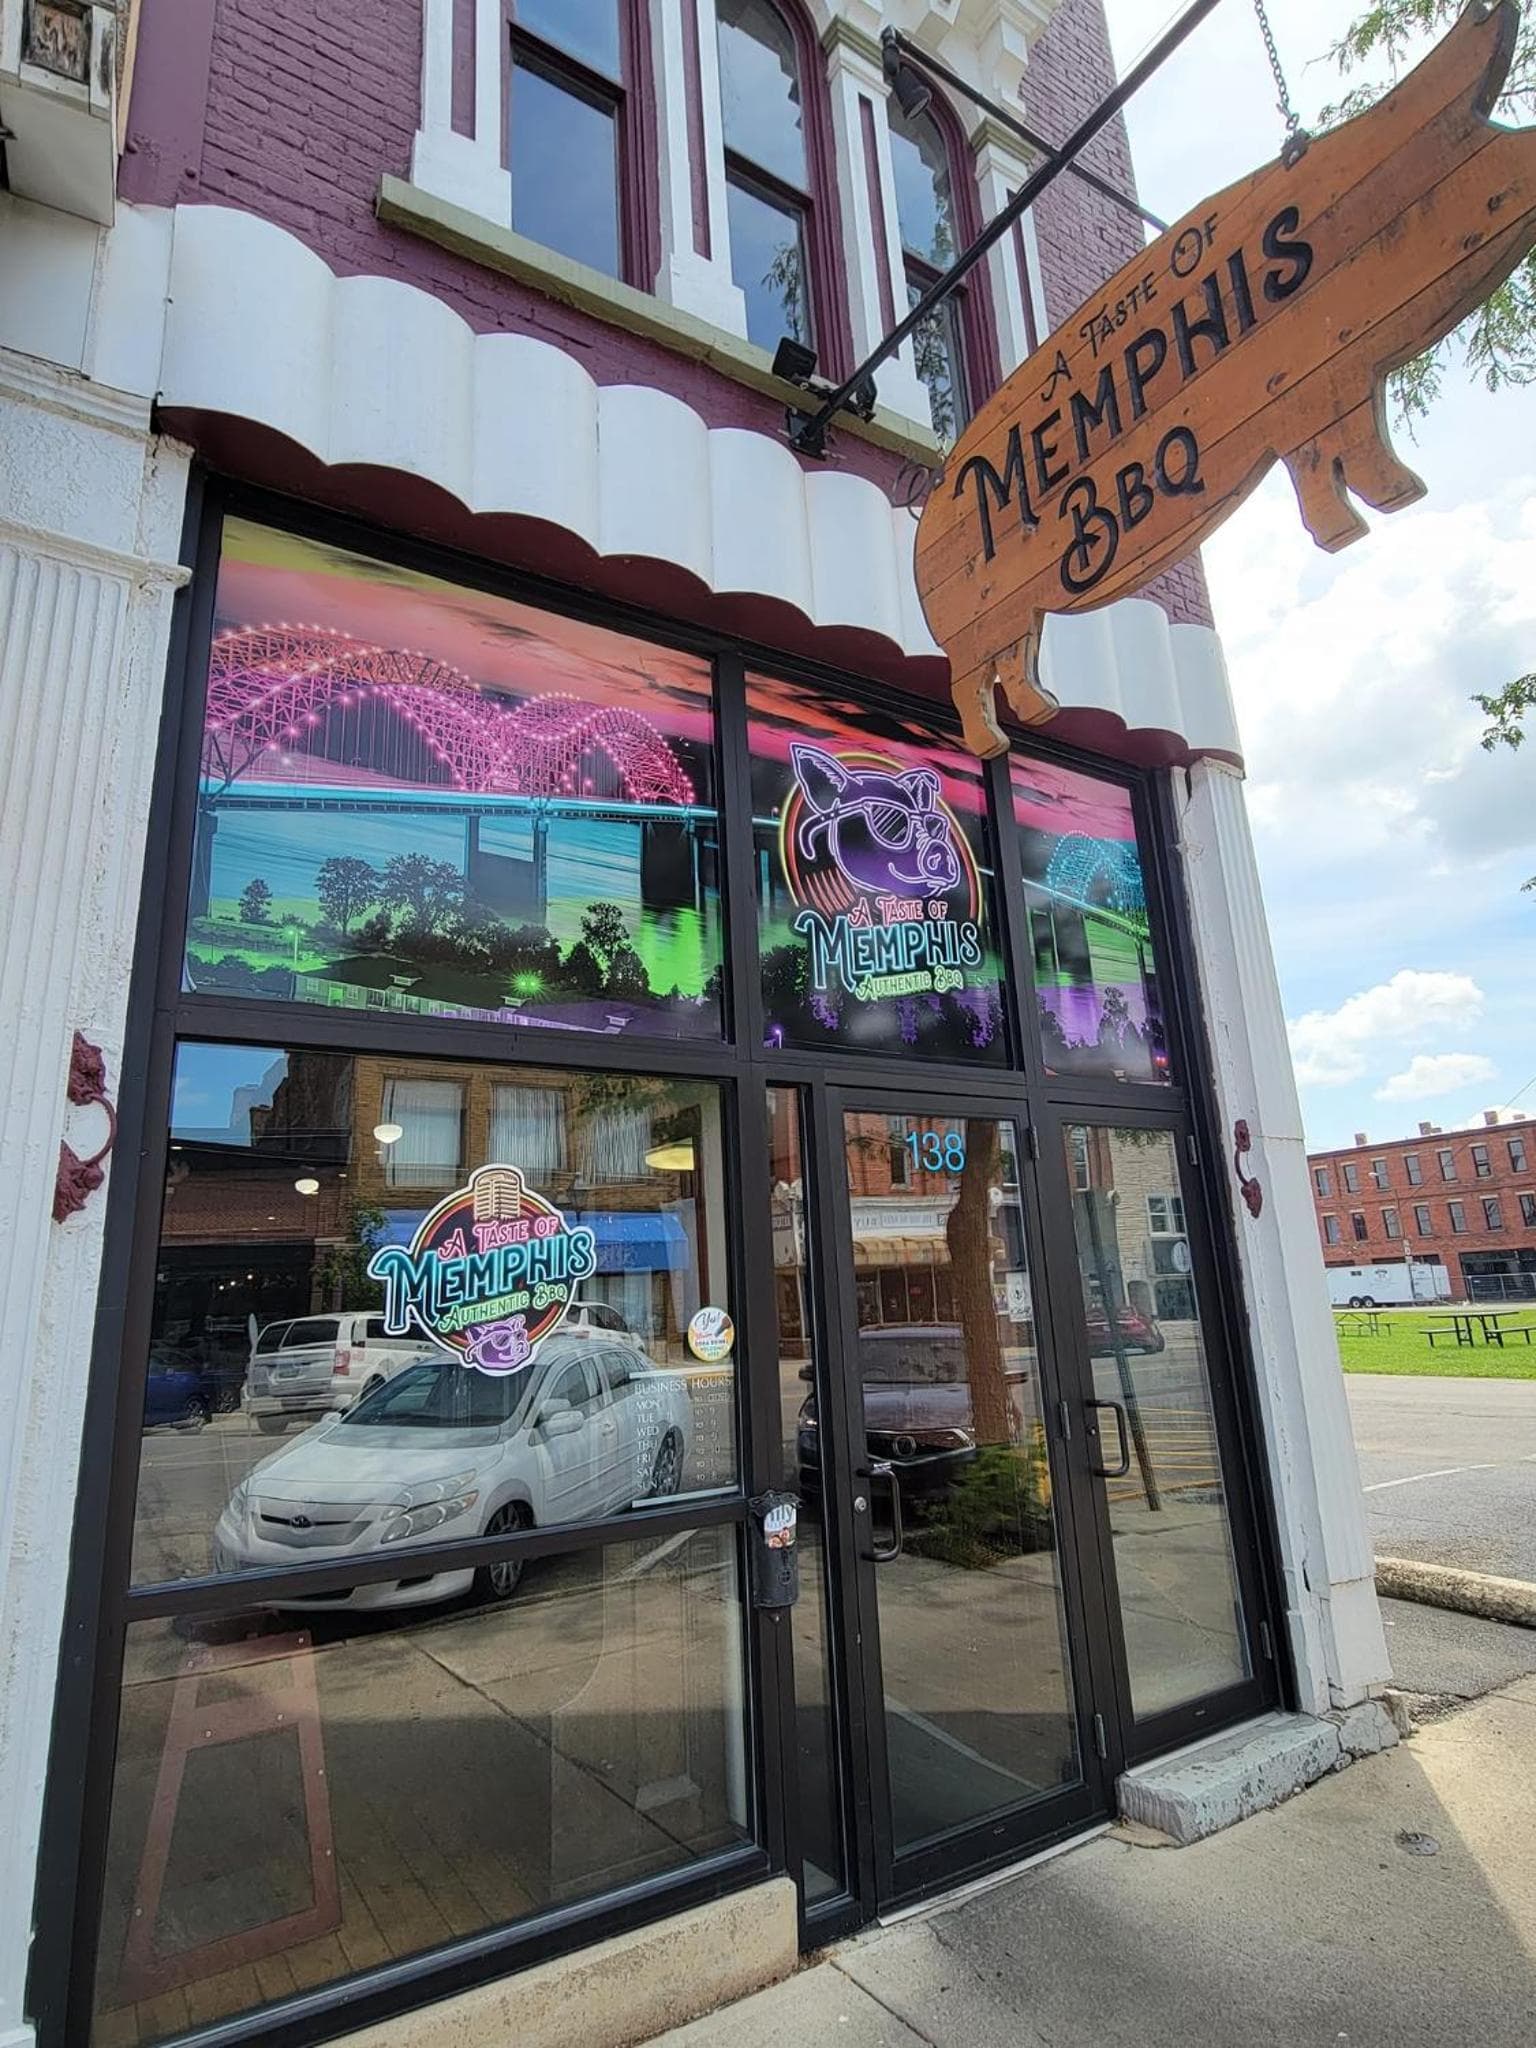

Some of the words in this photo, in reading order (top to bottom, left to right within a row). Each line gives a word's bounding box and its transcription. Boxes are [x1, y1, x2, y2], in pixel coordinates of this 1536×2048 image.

[1041, 349, 1073, 400] A
[1080, 274, 1158, 358] TASTE
[1170, 212, 1219, 279] OF
[952, 205, 1315, 564] MEMPHIS
[1058, 425, 1206, 594] BBQ
[848, 897, 873, 927] A
[876, 895, 924, 923] TASTE
[928, 900, 948, 918] OF
[794, 910, 982, 993] MEMPHIS
[855, 970, 932, 1000] AUTHENTIC
[933, 964, 963, 993] BBQ
[905, 1130, 966, 1173] 138
[437, 1228, 467, 1260] A
[472, 1220, 530, 1254] TASTE
[534, 1216, 559, 1239] OF
[371, 1232, 593, 1330] MEMPHIS
[437, 1290, 530, 1332] AUTHENTIC
[532, 1282, 568, 1309] BBQ
[634, 1380, 687, 1395] BUSINESS
[691, 1376, 731, 1390] HOURS
[636, 1426, 659, 1436] WED
[638, 1412, 653, 1423] TUE
